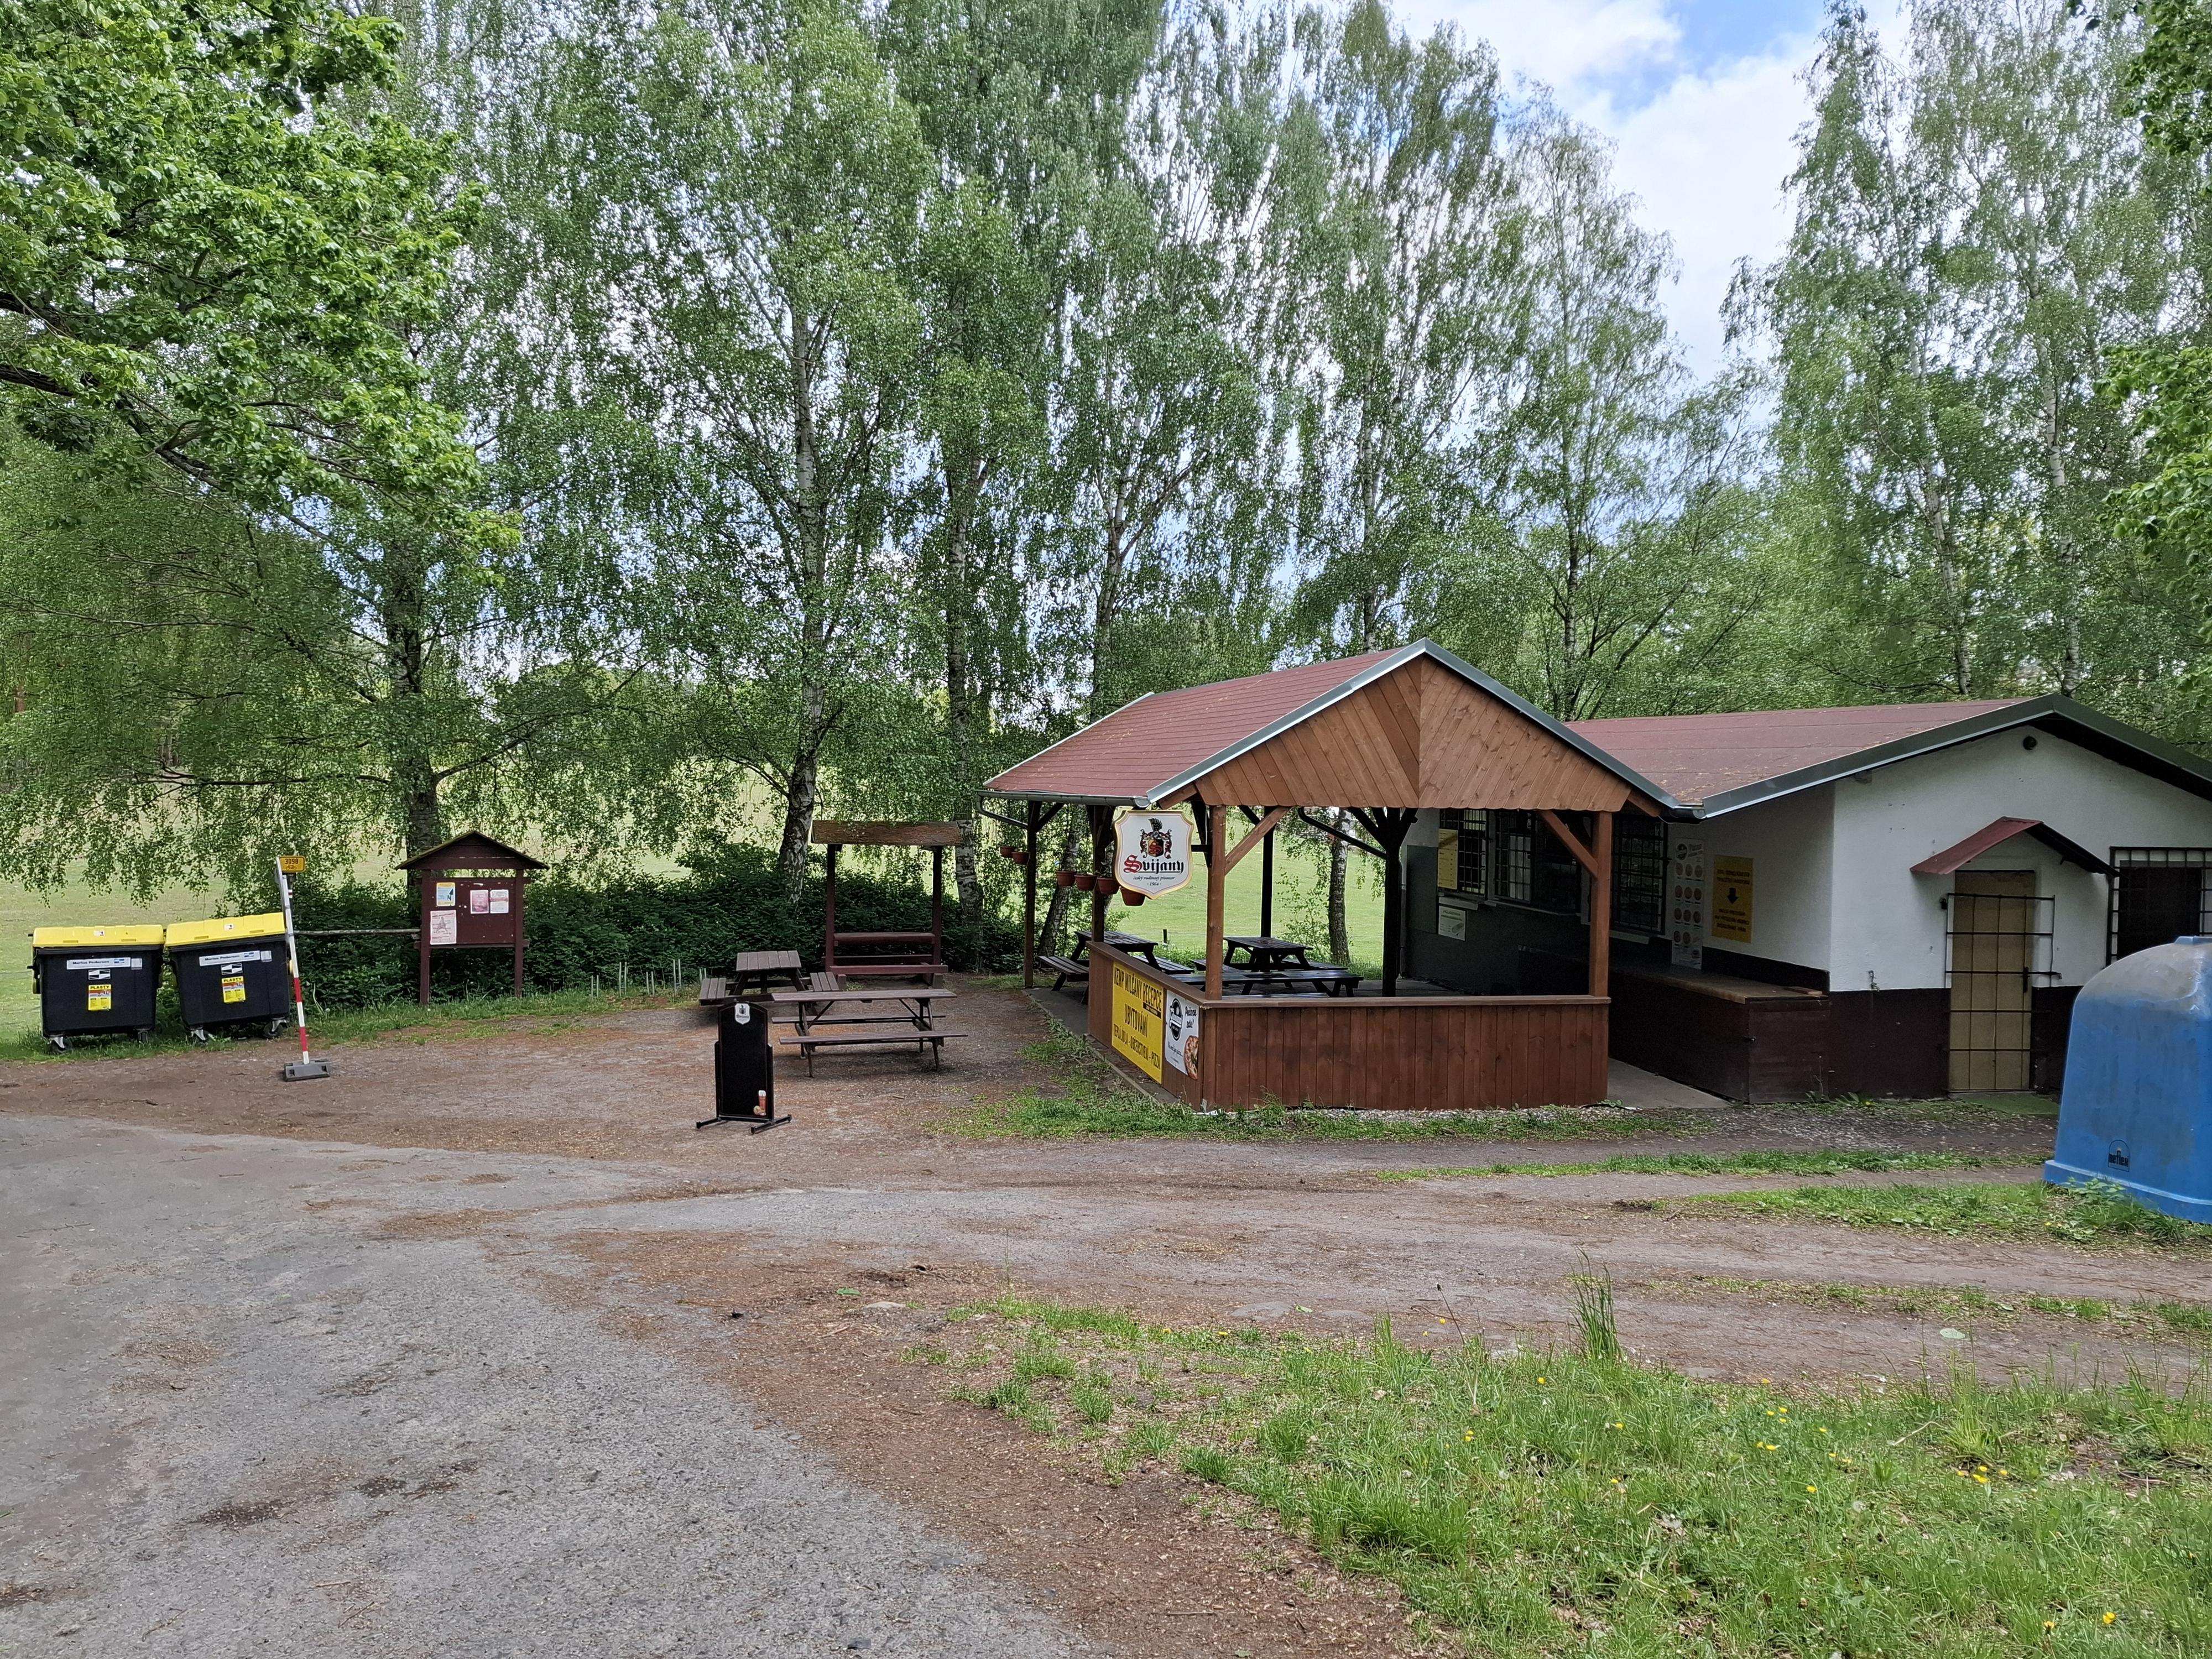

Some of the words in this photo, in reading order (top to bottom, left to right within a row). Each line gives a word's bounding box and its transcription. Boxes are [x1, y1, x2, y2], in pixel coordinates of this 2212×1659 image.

[1123, 854, 1184, 874] Svijany
[1125, 972, 1142, 1000] MILČANY
[1142, 982, 1162, 1011] RECEPCE
[1124, 1003, 1149, 1038] UBYTOVÁNÍ
[1151, 1051, 1161, 1070] PIZZA
